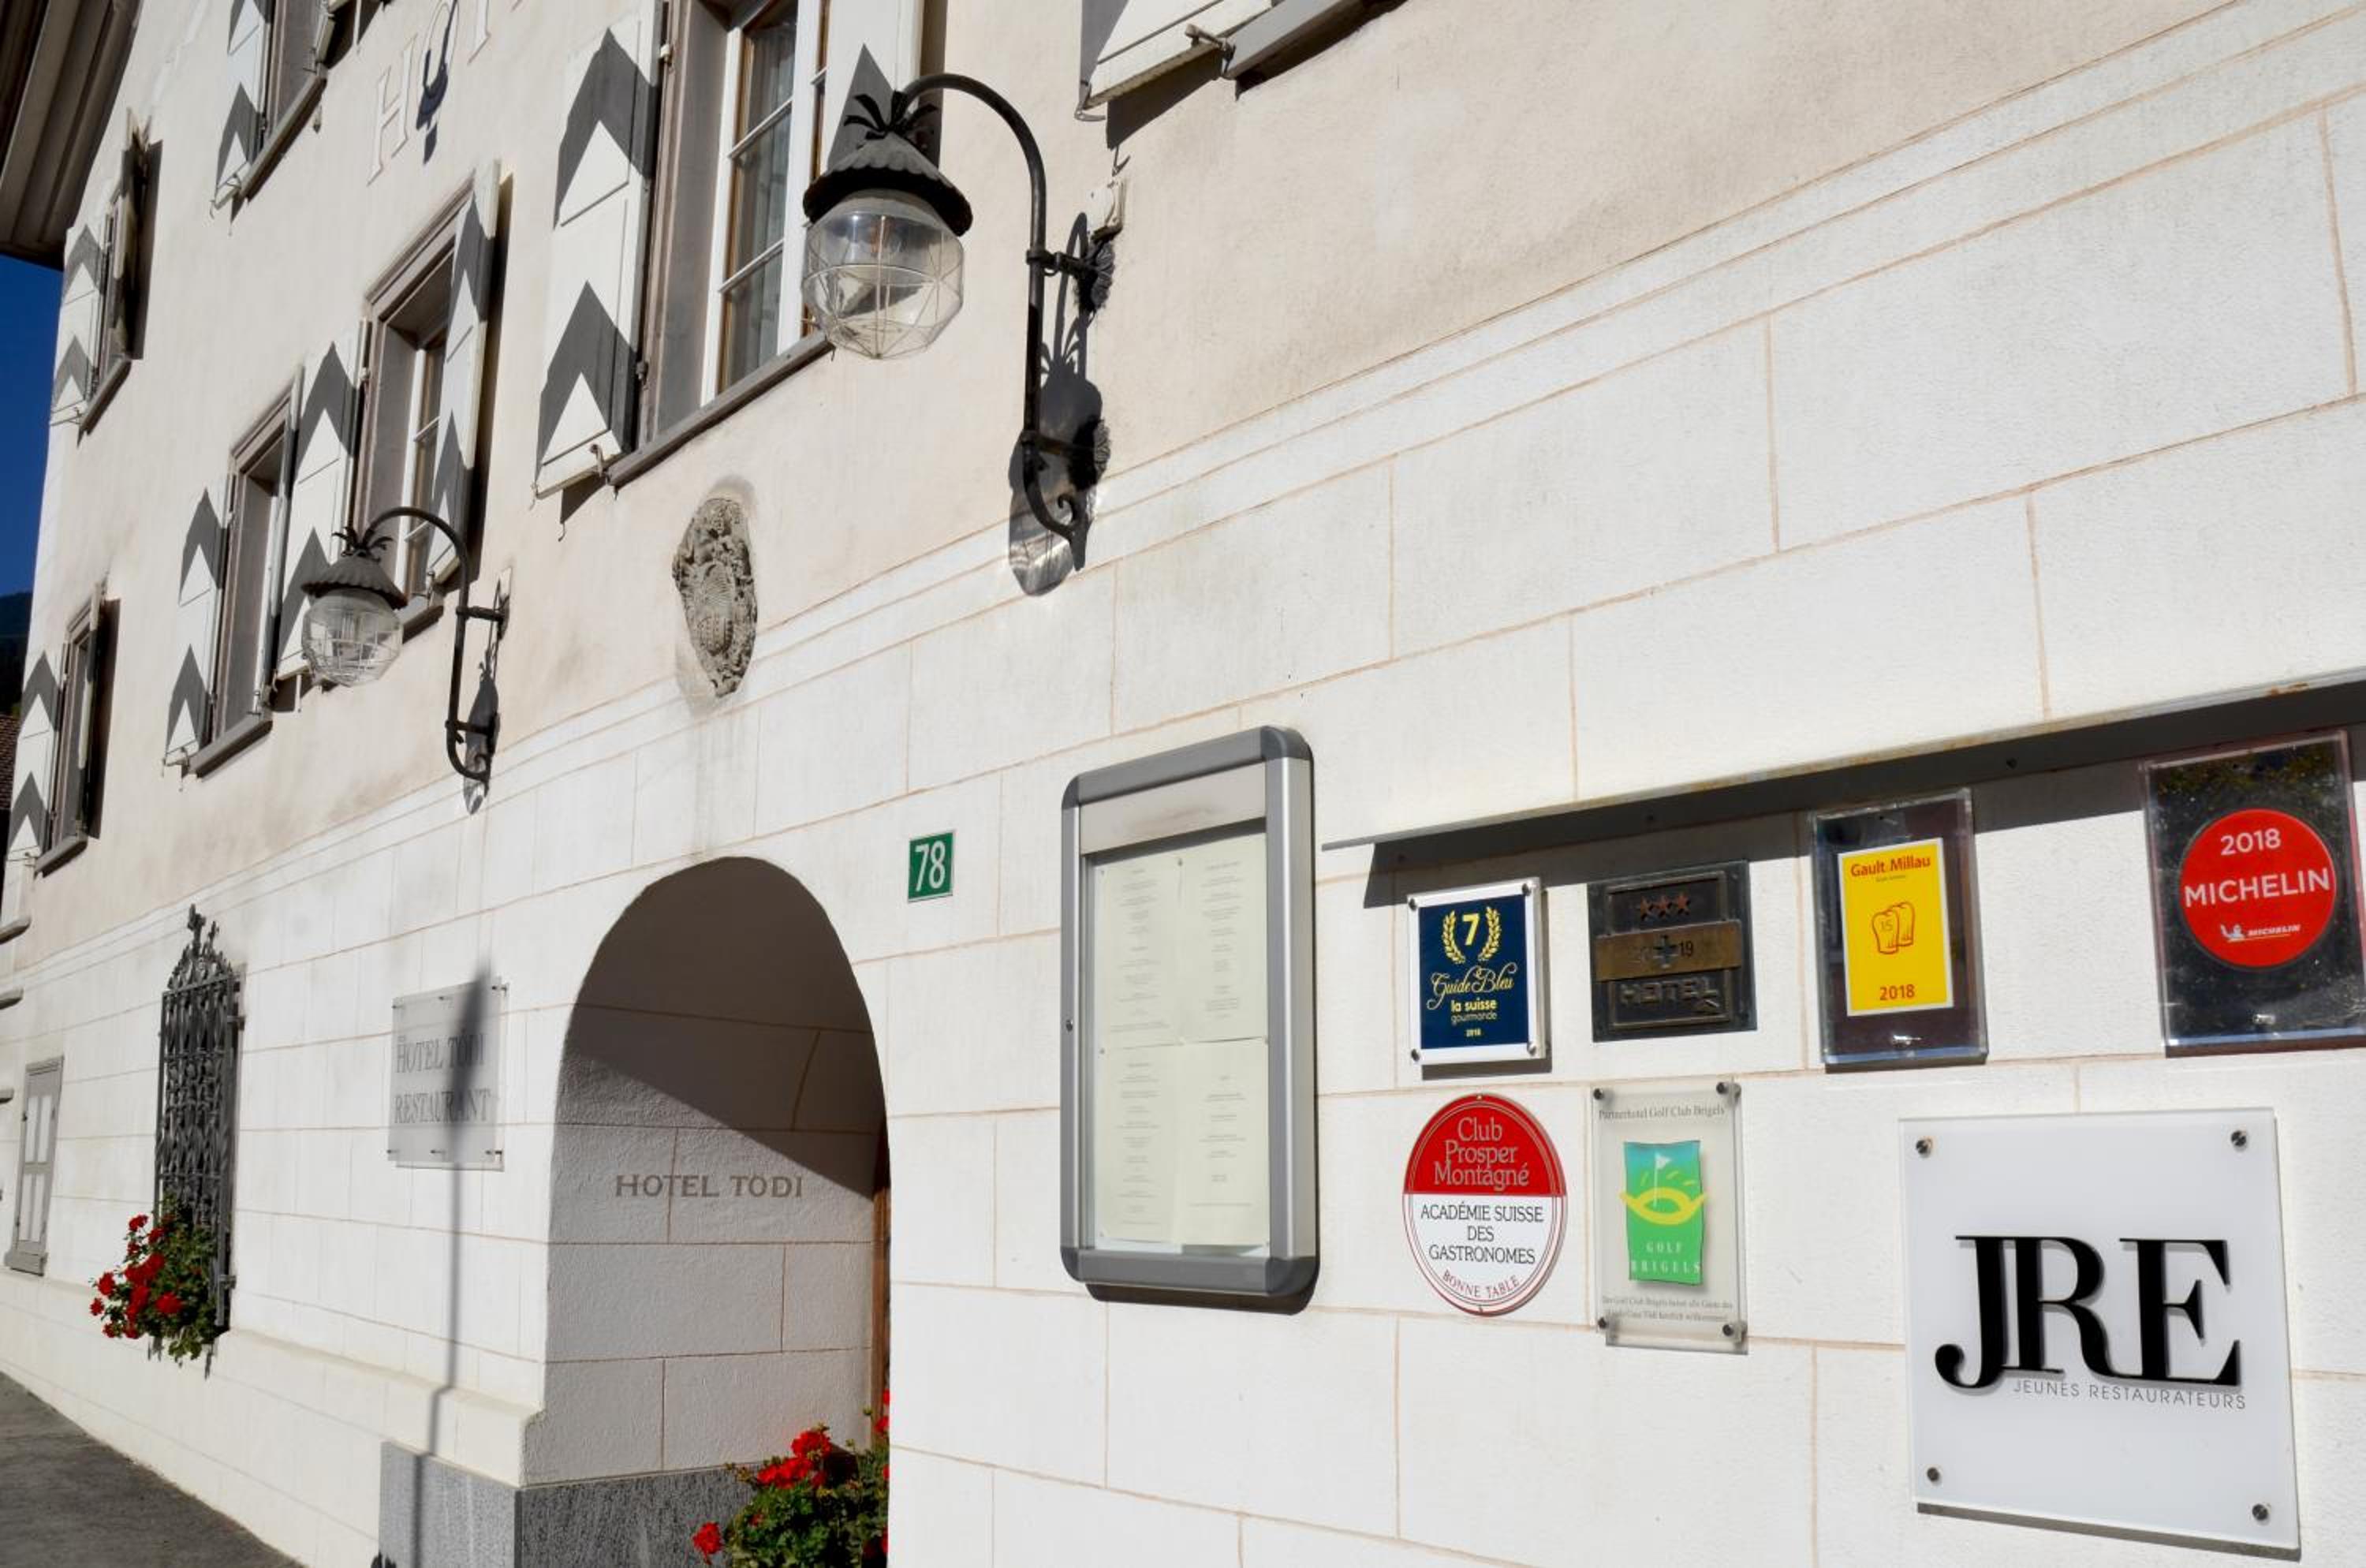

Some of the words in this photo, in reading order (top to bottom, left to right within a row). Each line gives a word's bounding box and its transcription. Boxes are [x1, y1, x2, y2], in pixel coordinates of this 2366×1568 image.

[2220, 827, 2282, 856] 2018
[915, 840, 946, 892] 78
[1851, 861, 1886, 877] Gault
[1890, 855, 1931, 872] Millau
[2184, 868, 2331, 908] MICHELIN
[1462, 913, 1480, 946] 7
[2248, 924, 2301, 936] MICHELIN
[1426, 965, 1480, 1010] Guide
[1471, 961, 1518, 994] Bleu
[1619, 976, 1719, 1006] HOTEL
[1879, 984, 1916, 1001] 2018
[1450, 999, 1461, 1012] la
[1465, 997, 1498, 1012] suisse
[1450, 1010, 1498, 1026] gourmande
[396, 1038, 443, 1073] HOTEL
[1649, 1105, 1668, 1118] Golf
[1670, 1105, 1692, 1117] Club
[1457, 1116, 1502, 1141] Club
[1444, 1139, 1518, 1168] Prosper
[616, 1174, 719, 1197] HOTEL
[1434, 1161, 1530, 1192] Montagné
[1420, 1201, 1491, 1221] ACADÉMIE
[1494, 1205, 1544, 1223] SUISSE
[1467, 1226, 1495, 1242] DES
[1428, 1244, 1536, 1264] GASTRONOMES
[1646, 1241, 1683, 1253] GOLF
[1631, 1259, 1700, 1275] BRIGELS
[1442, 1269, 1481, 1298] BONNE
[1485, 1274, 1520, 1299] TABLE
[1935, 1235, 2241, 1388] JRE
[2013, 1379, 2081, 1398] JEUNES
[2089, 1383, 2246, 1409] RESTAURATEURS
